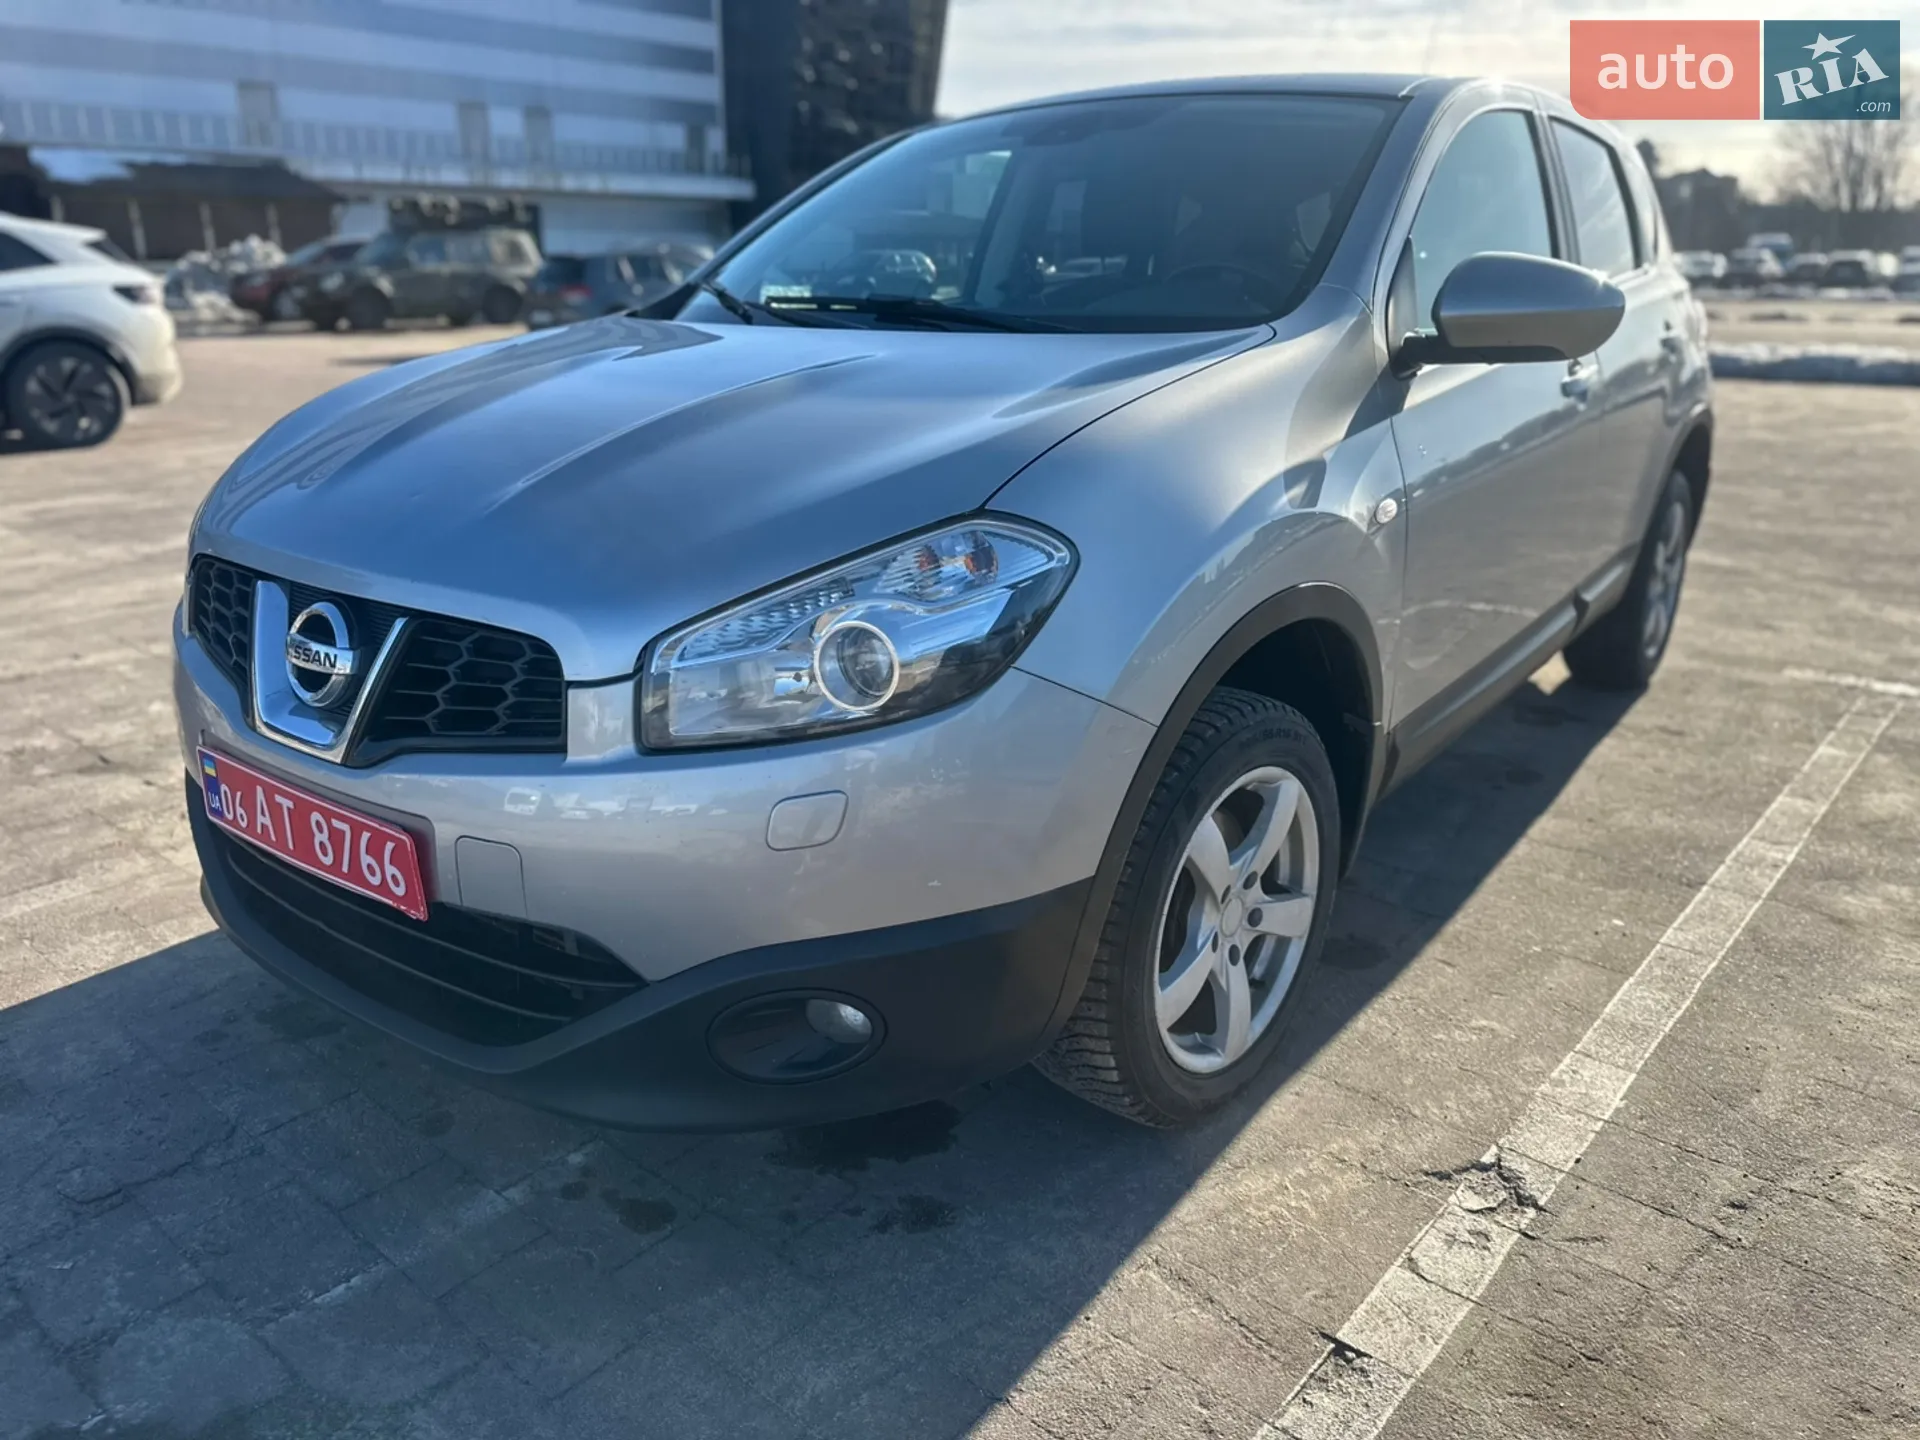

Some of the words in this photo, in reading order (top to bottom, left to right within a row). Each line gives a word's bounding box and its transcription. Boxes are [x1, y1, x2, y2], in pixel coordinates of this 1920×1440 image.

[208, 791, 222, 812] UA
[220, 783, 248, 829] 06
[256, 785, 294, 851] AT
[310, 811, 407, 897] 8766
